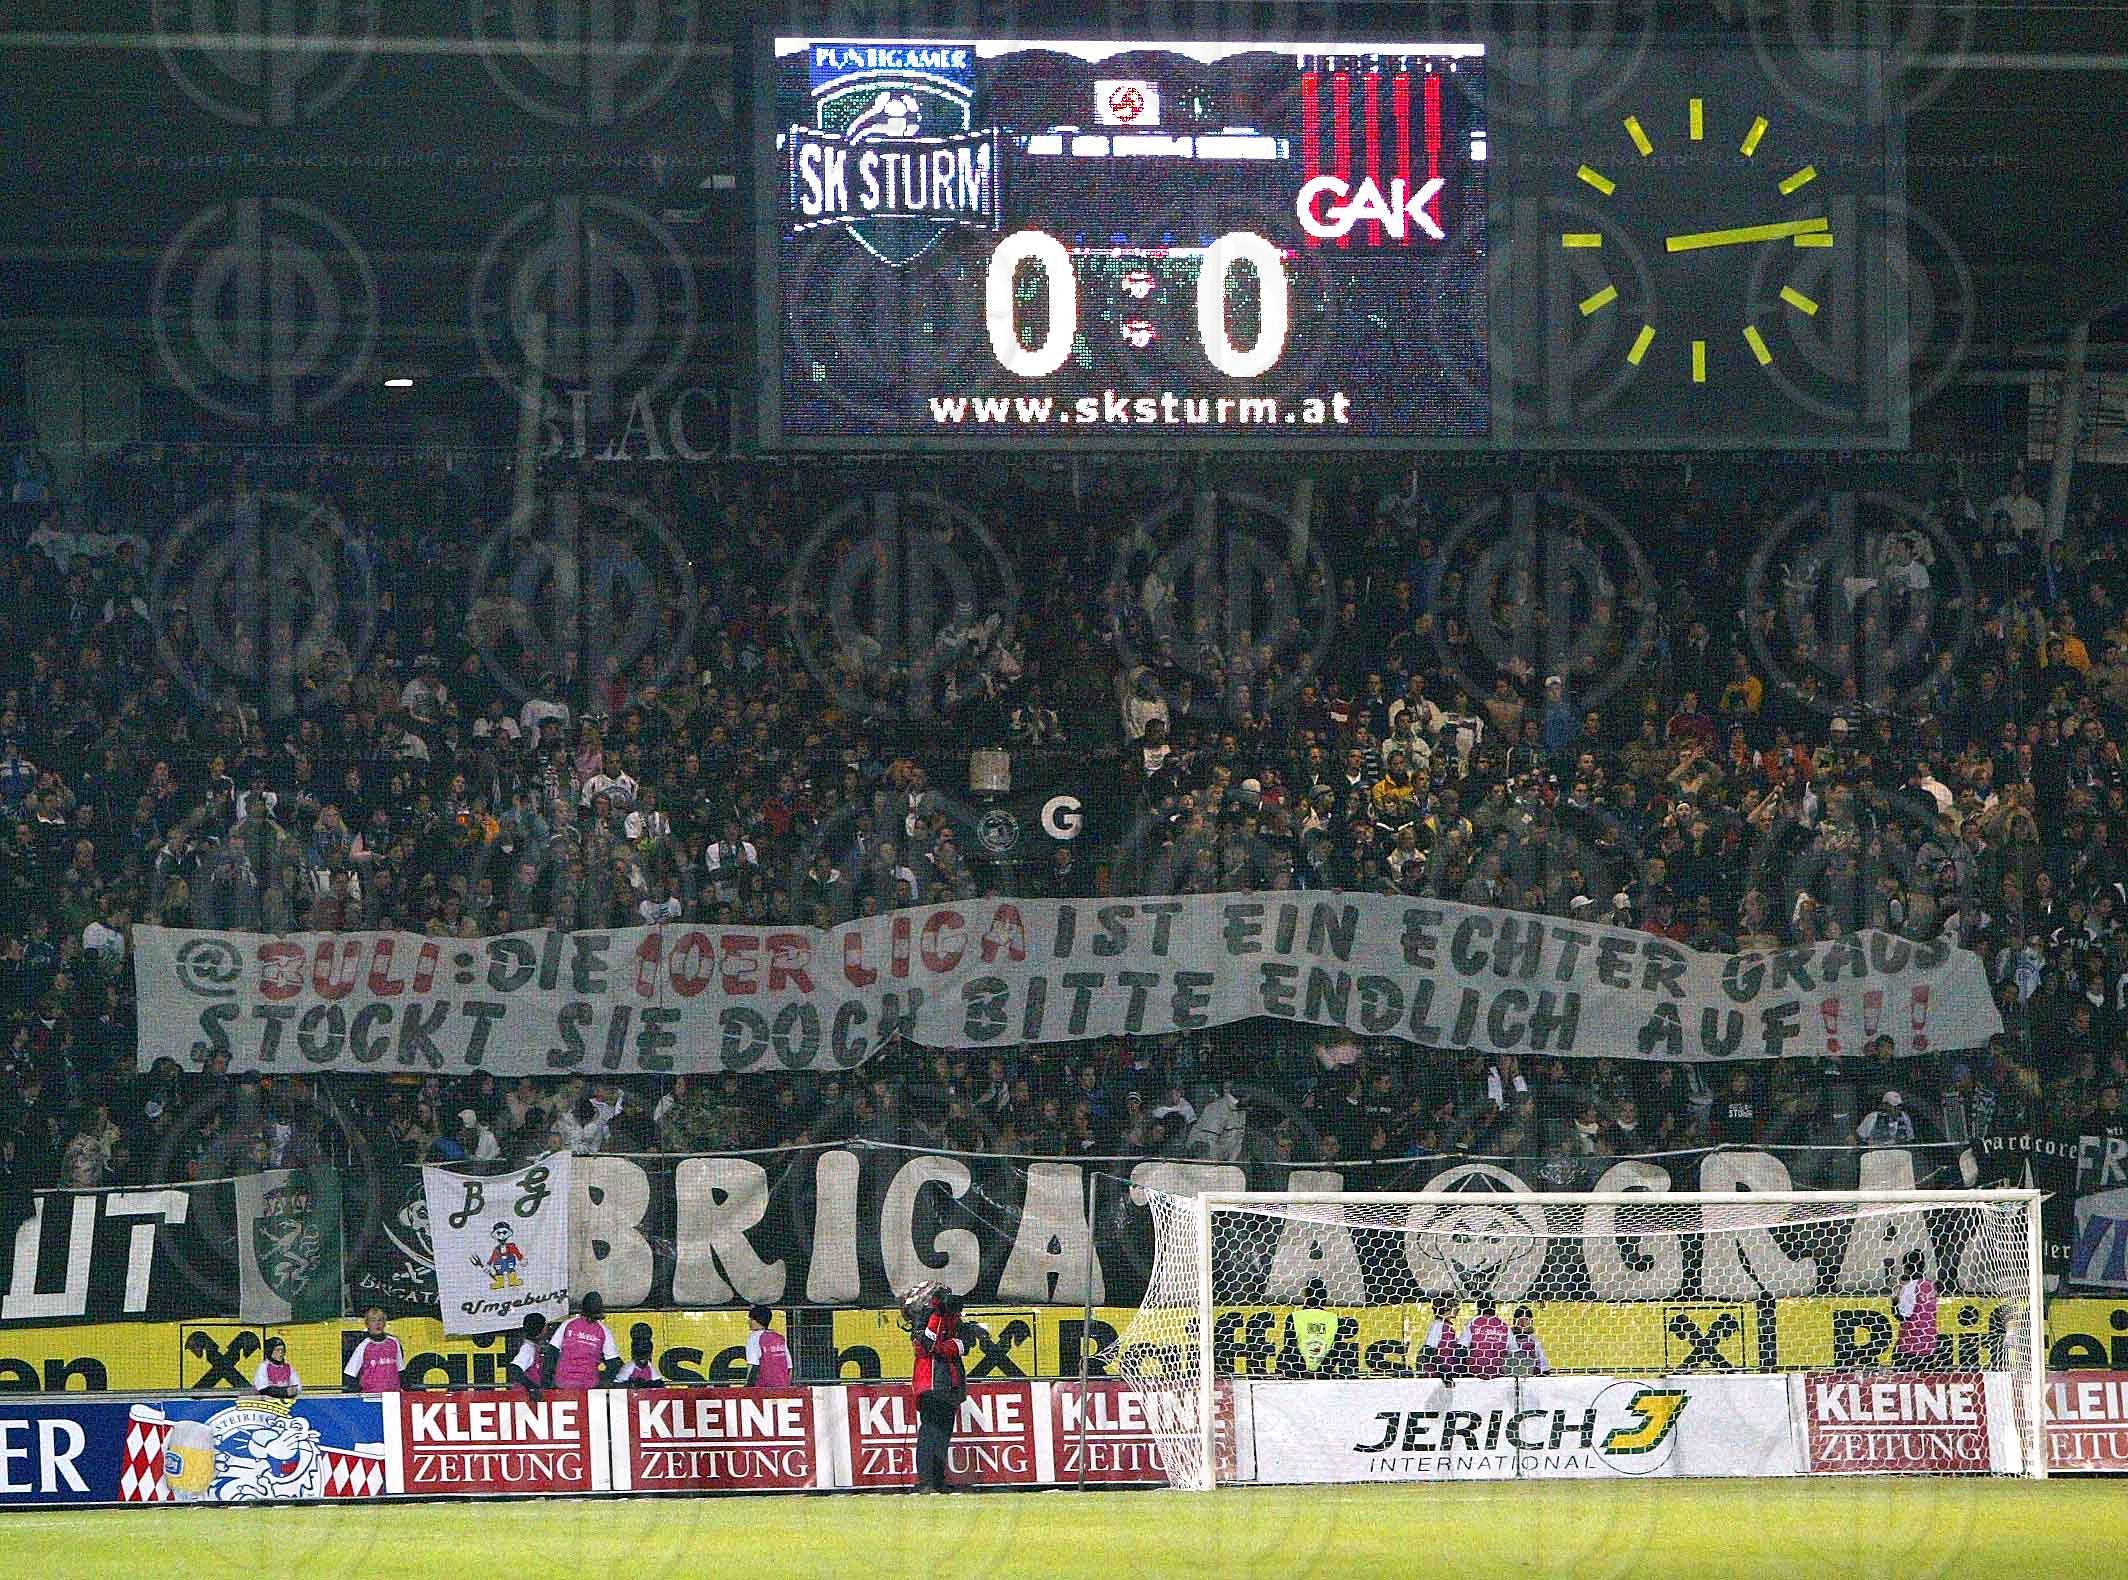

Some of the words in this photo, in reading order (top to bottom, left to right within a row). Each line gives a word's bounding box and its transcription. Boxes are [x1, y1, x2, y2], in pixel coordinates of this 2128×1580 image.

[799, 143, 848, 215] SK
[859, 143, 992, 215] STURM
[1296, 175, 1446, 241] GAK
[986, 230, 1078, 378] 0
[1196, 231, 1289, 378] 0
[929, 391, 1353, 425] www.sksturm.at
[1040, 796, 1084, 840] G
[844, 904, 1026, 988] LIGA
[1054, 901, 1183, 957] IST
[1223, 903, 1359, 961] EIN
[1402, 908, 1688, 999] ECHTER
[190, 1002, 507, 1069] STOCKT
[547, 1000, 682, 1070] SIE
[719, 987, 923, 1069] DOCH
[960, 971, 1214, 1043] BITTE
[1260, 962, 1581, 1052] ENDLICH
[460, 1288, 568, 1317] Umgebung
[640, 1399, 805, 1438] KLEINE
[860, 1394, 1025, 1435] KLNE
[1815, 1383, 1976, 1421] KLEINE
[2044, 1382, 2128, 1420] LEI
[411, 1402, 580, 1441] KLEINE
[1353, 1409, 1597, 1453] JERICH
[640, 1449, 809, 1480] ZEITUNG
[861, 1444, 1028, 1476] ZEIUNG
[1370, 1456, 1597, 1473] INTERNATIONAL
[1820, 1433, 1980, 1461] ZEITUNG
[413, 1453, 584, 1482] ZEITUNG
